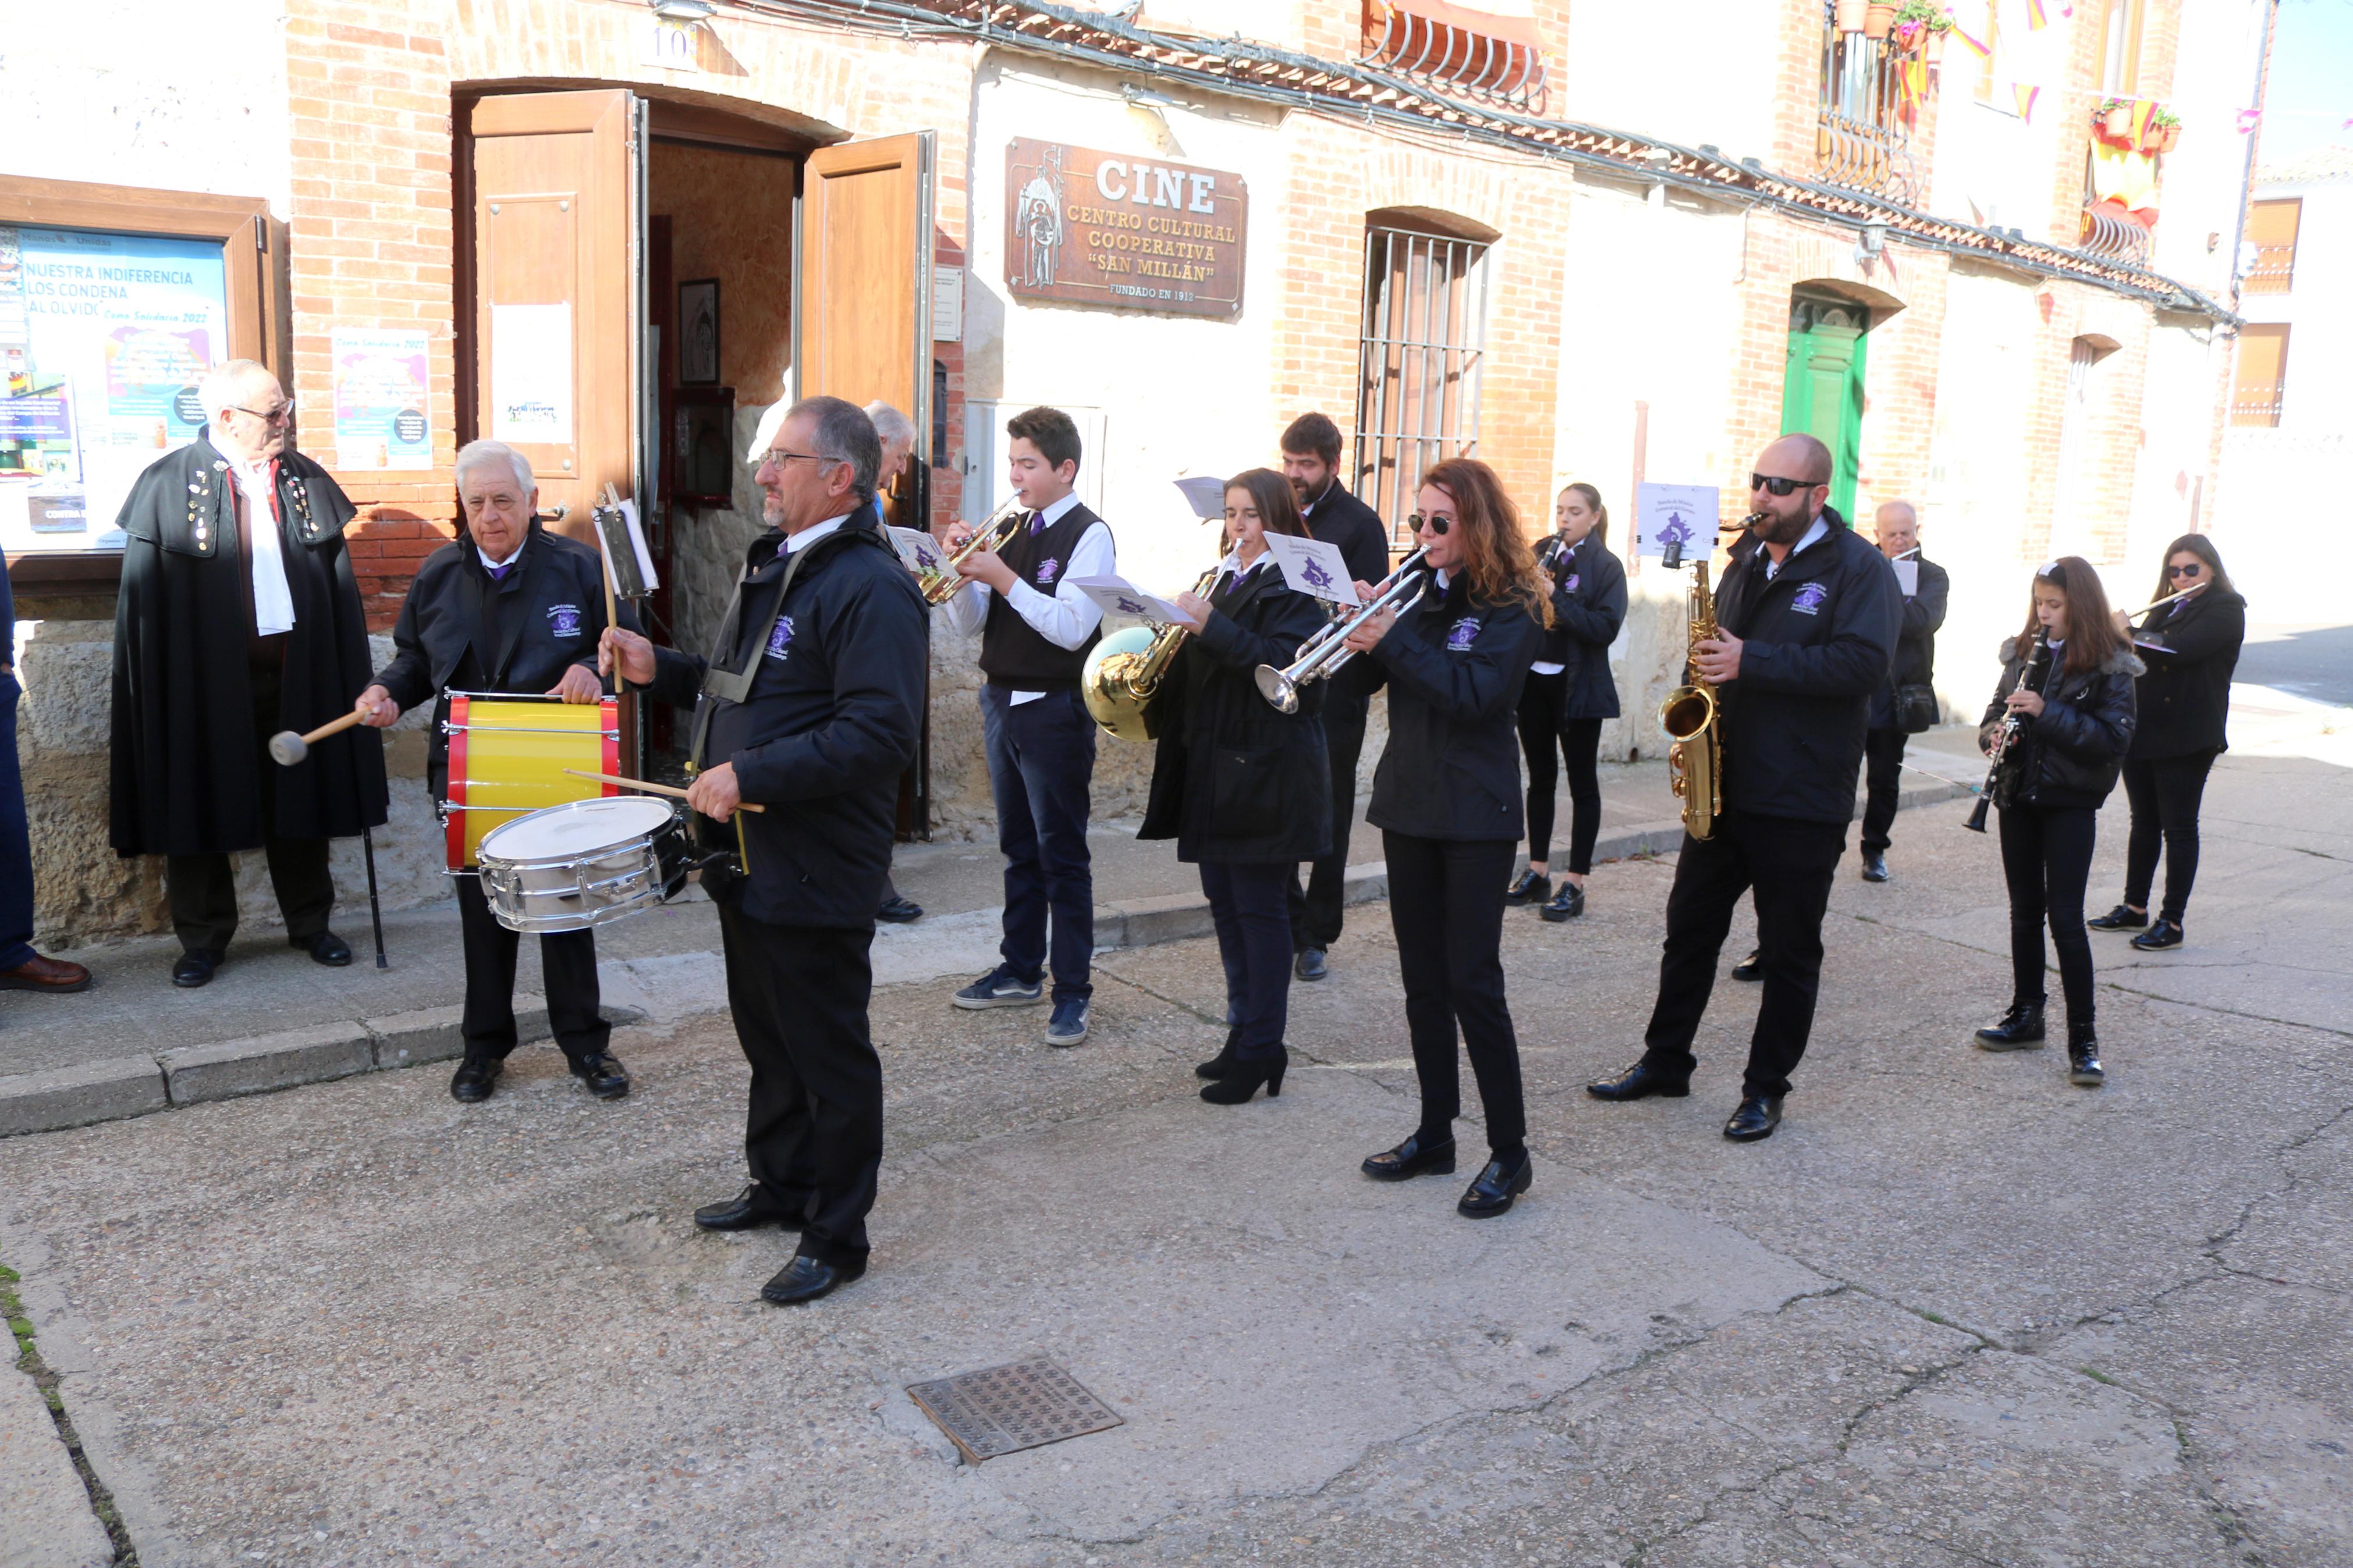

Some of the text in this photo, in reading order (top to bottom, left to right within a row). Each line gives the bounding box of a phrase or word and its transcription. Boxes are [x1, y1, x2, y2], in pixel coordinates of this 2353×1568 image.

[653, 26, 687, 59] 10
[1096, 159, 1215, 214] CINE
[1067, 205, 1235, 244] CENTRO CULTURAL
[76, 237, 112, 247] Unidas
[1088, 230, 1215, 262] COOPERATIVA
[26, 264, 193, 285] NUESTRA INDIFERENCIA
[28, 282, 128, 299] LOS CONDENA
[1110, 284, 1194, 302] FUNDADO EN 1912
[30, 300, 47, 314] AL
[134, 311, 179, 322] Solidaria
[183, 312, 207, 323] 2022
[45, 510, 81, 519] CONTRA
